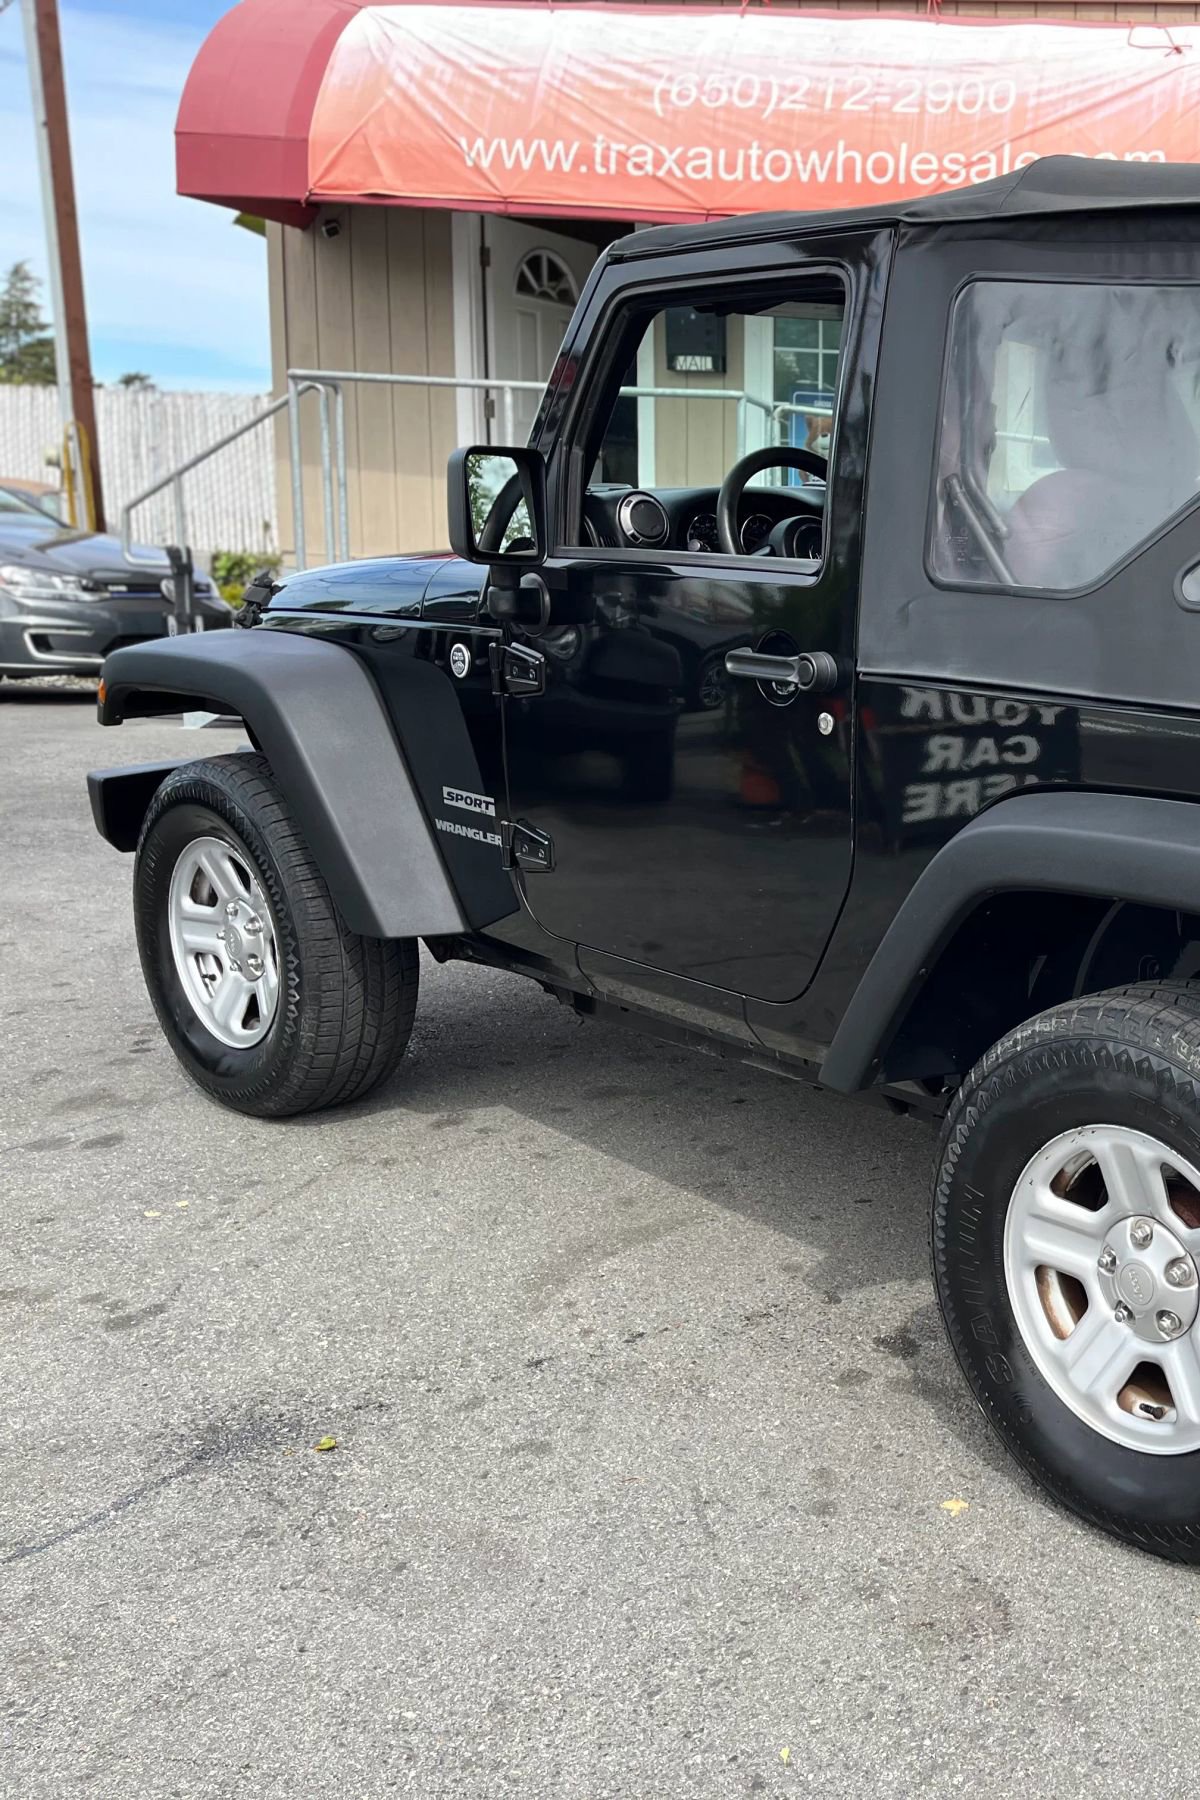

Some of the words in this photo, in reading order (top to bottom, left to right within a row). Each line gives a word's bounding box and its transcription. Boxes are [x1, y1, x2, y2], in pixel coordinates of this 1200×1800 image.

[653, 72, 1017, 118] (650)212-2900
[458, 134, 1167, 187] www.traxautowholesal
[675, 355, 713, 371] MAIL
[444, 791, 495, 811] SPORT
[435, 818, 503, 848] WRANGLER
